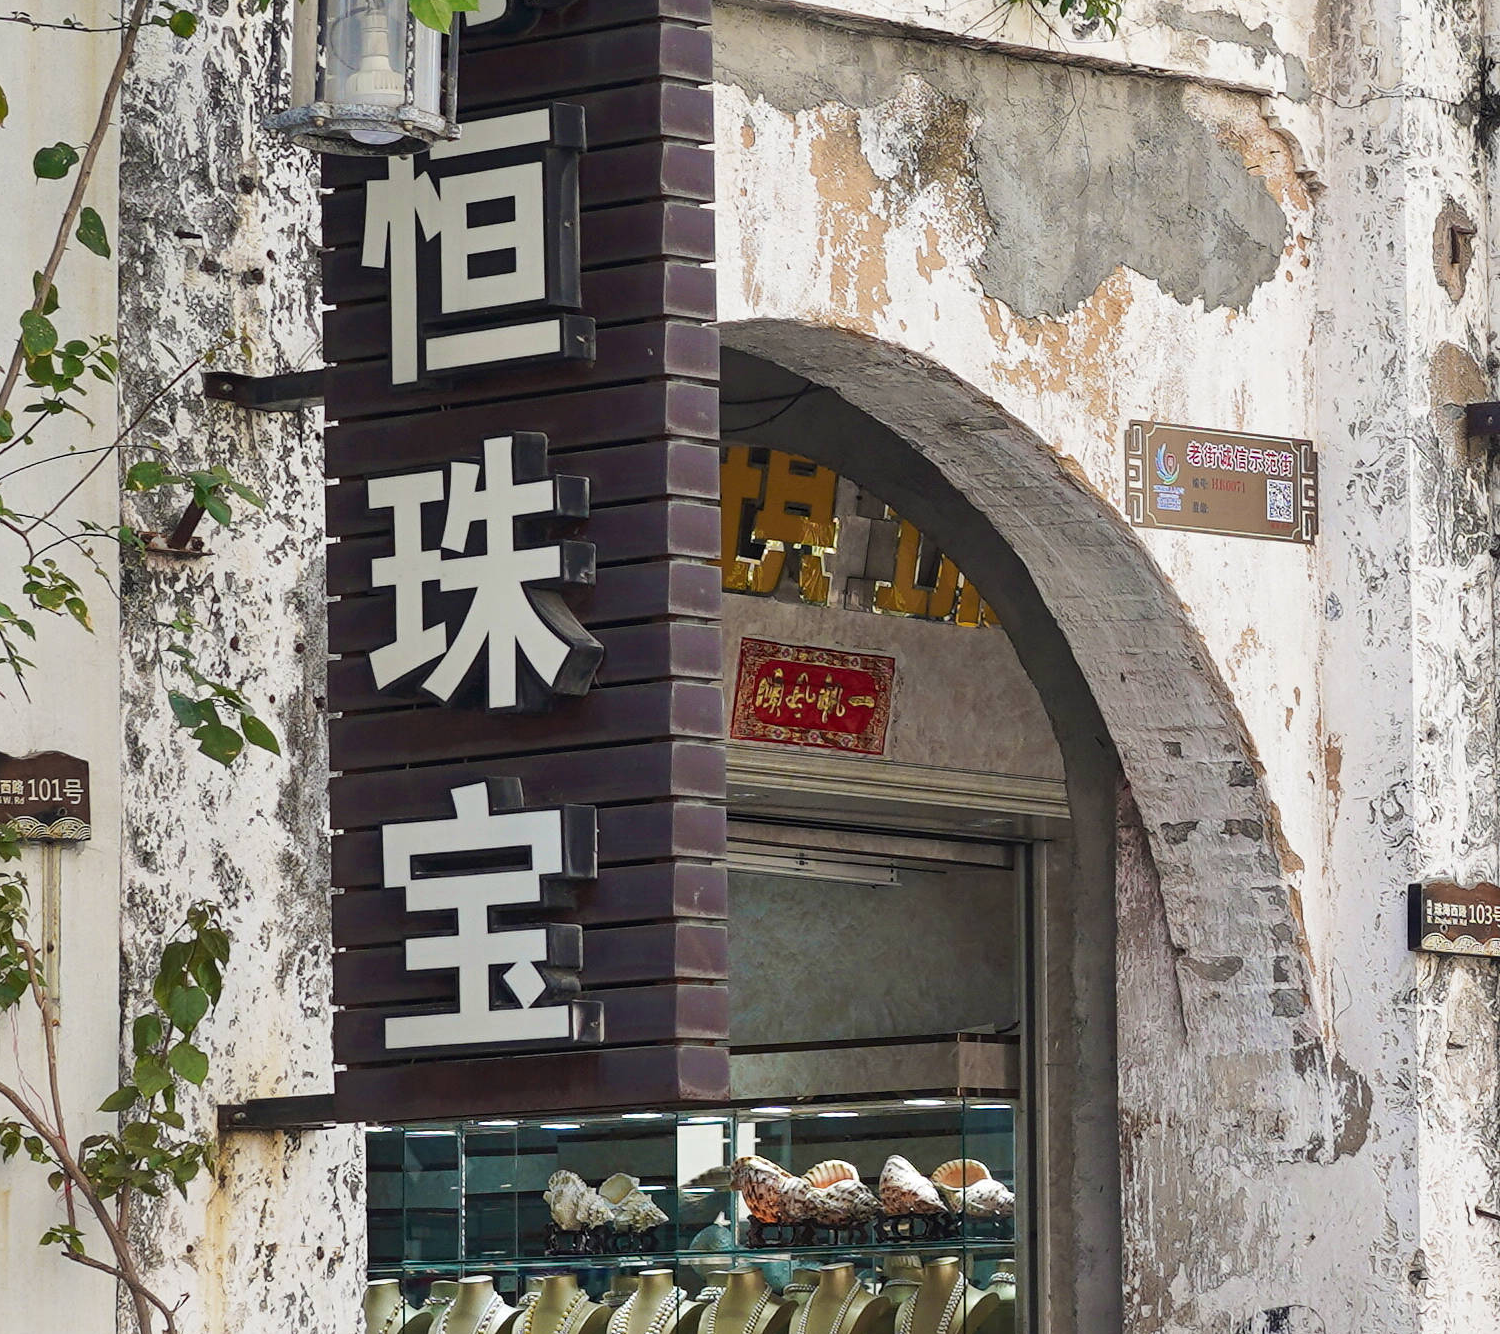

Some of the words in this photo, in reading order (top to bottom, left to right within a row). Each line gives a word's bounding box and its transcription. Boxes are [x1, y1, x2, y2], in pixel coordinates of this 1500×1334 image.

[1187, 440, 1294, 478] 老街诚信示范街
[27, 778, 84, 805] 101号
